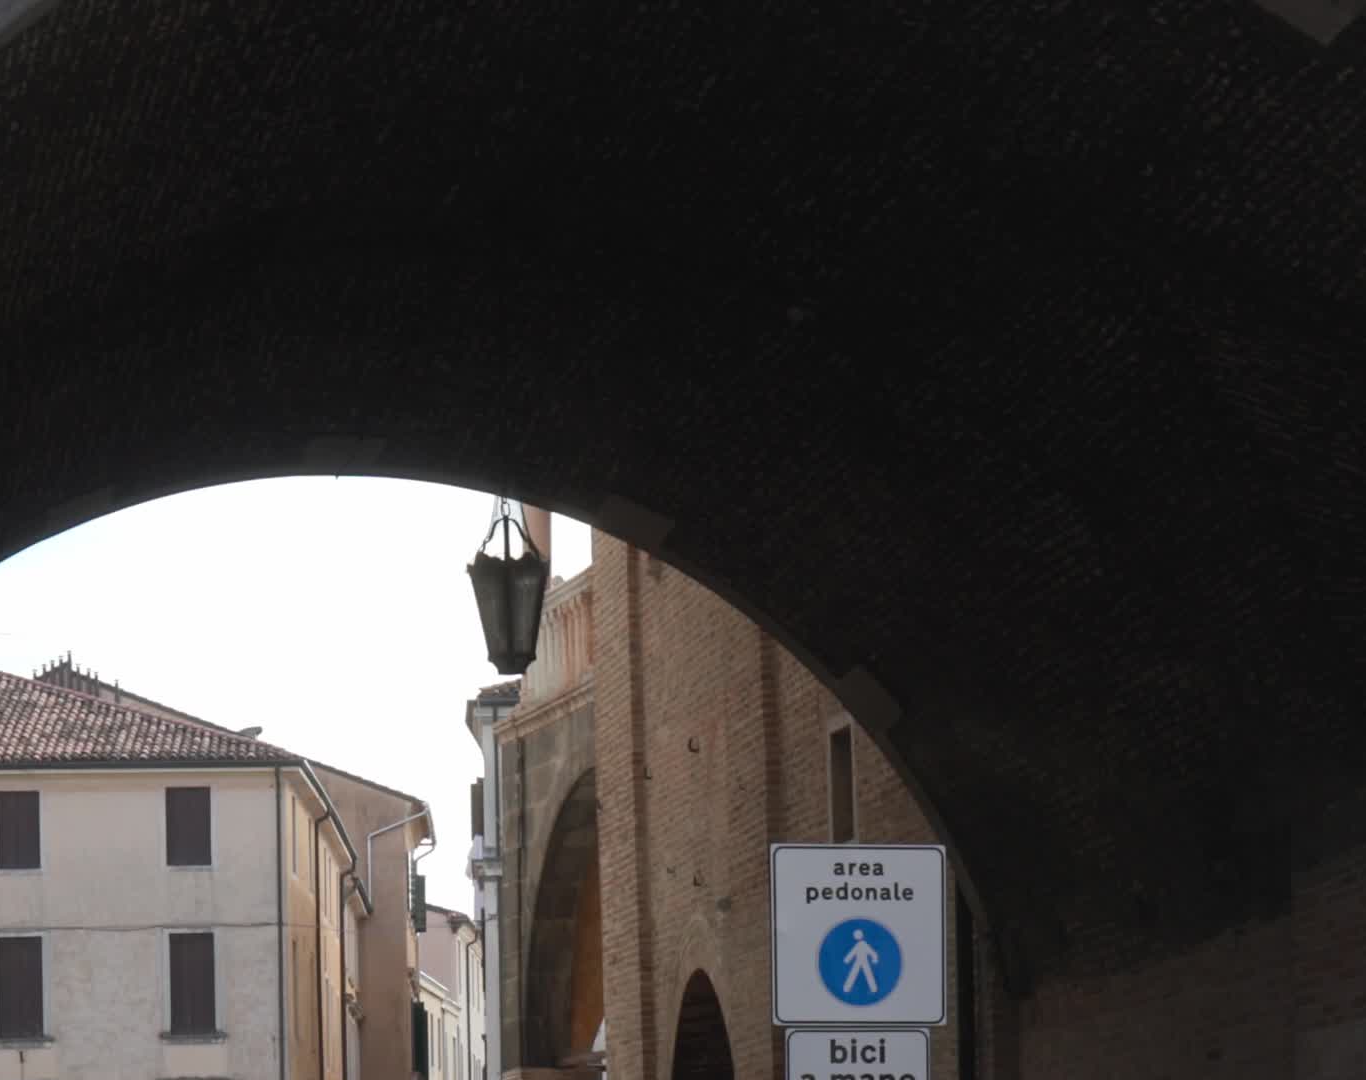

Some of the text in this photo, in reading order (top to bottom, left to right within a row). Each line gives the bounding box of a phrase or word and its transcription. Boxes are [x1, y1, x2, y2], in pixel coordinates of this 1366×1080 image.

[833, 862, 884, 876] area
[806, 882, 915, 904] pedonale
[830, 1039, 887, 1064] bici
